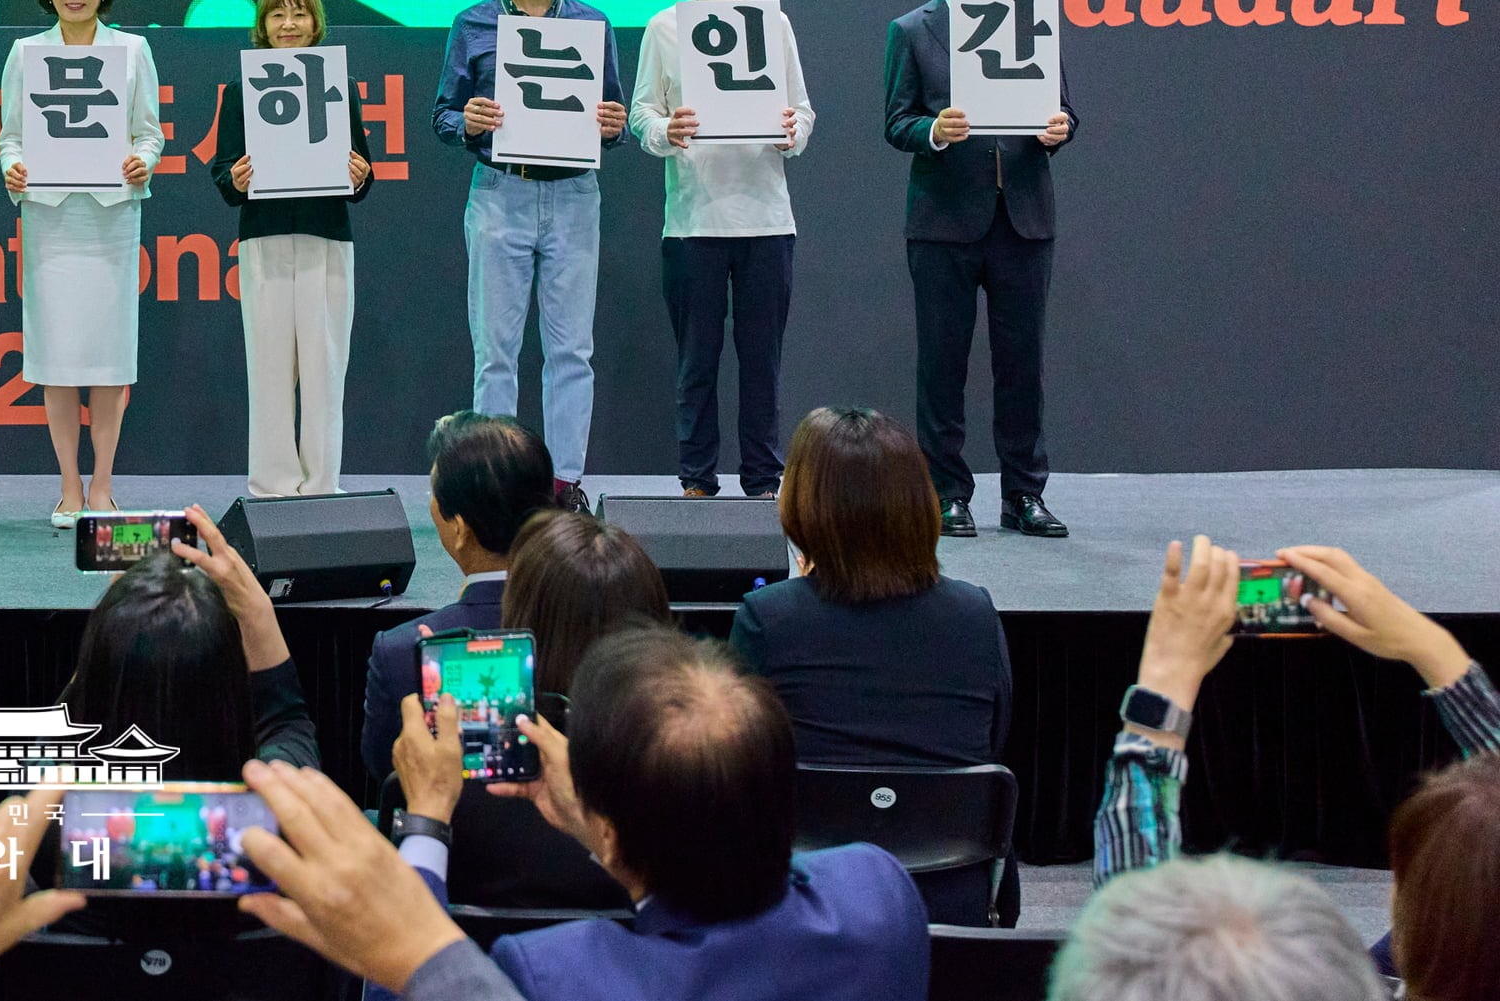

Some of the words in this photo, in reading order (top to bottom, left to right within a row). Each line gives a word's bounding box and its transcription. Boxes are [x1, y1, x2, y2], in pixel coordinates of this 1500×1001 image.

[503, 28, 595, 113] 는
[691, 5, 776, 91] 인
[29, 55, 119, 139] 문
[248, 53, 343, 144] 하
